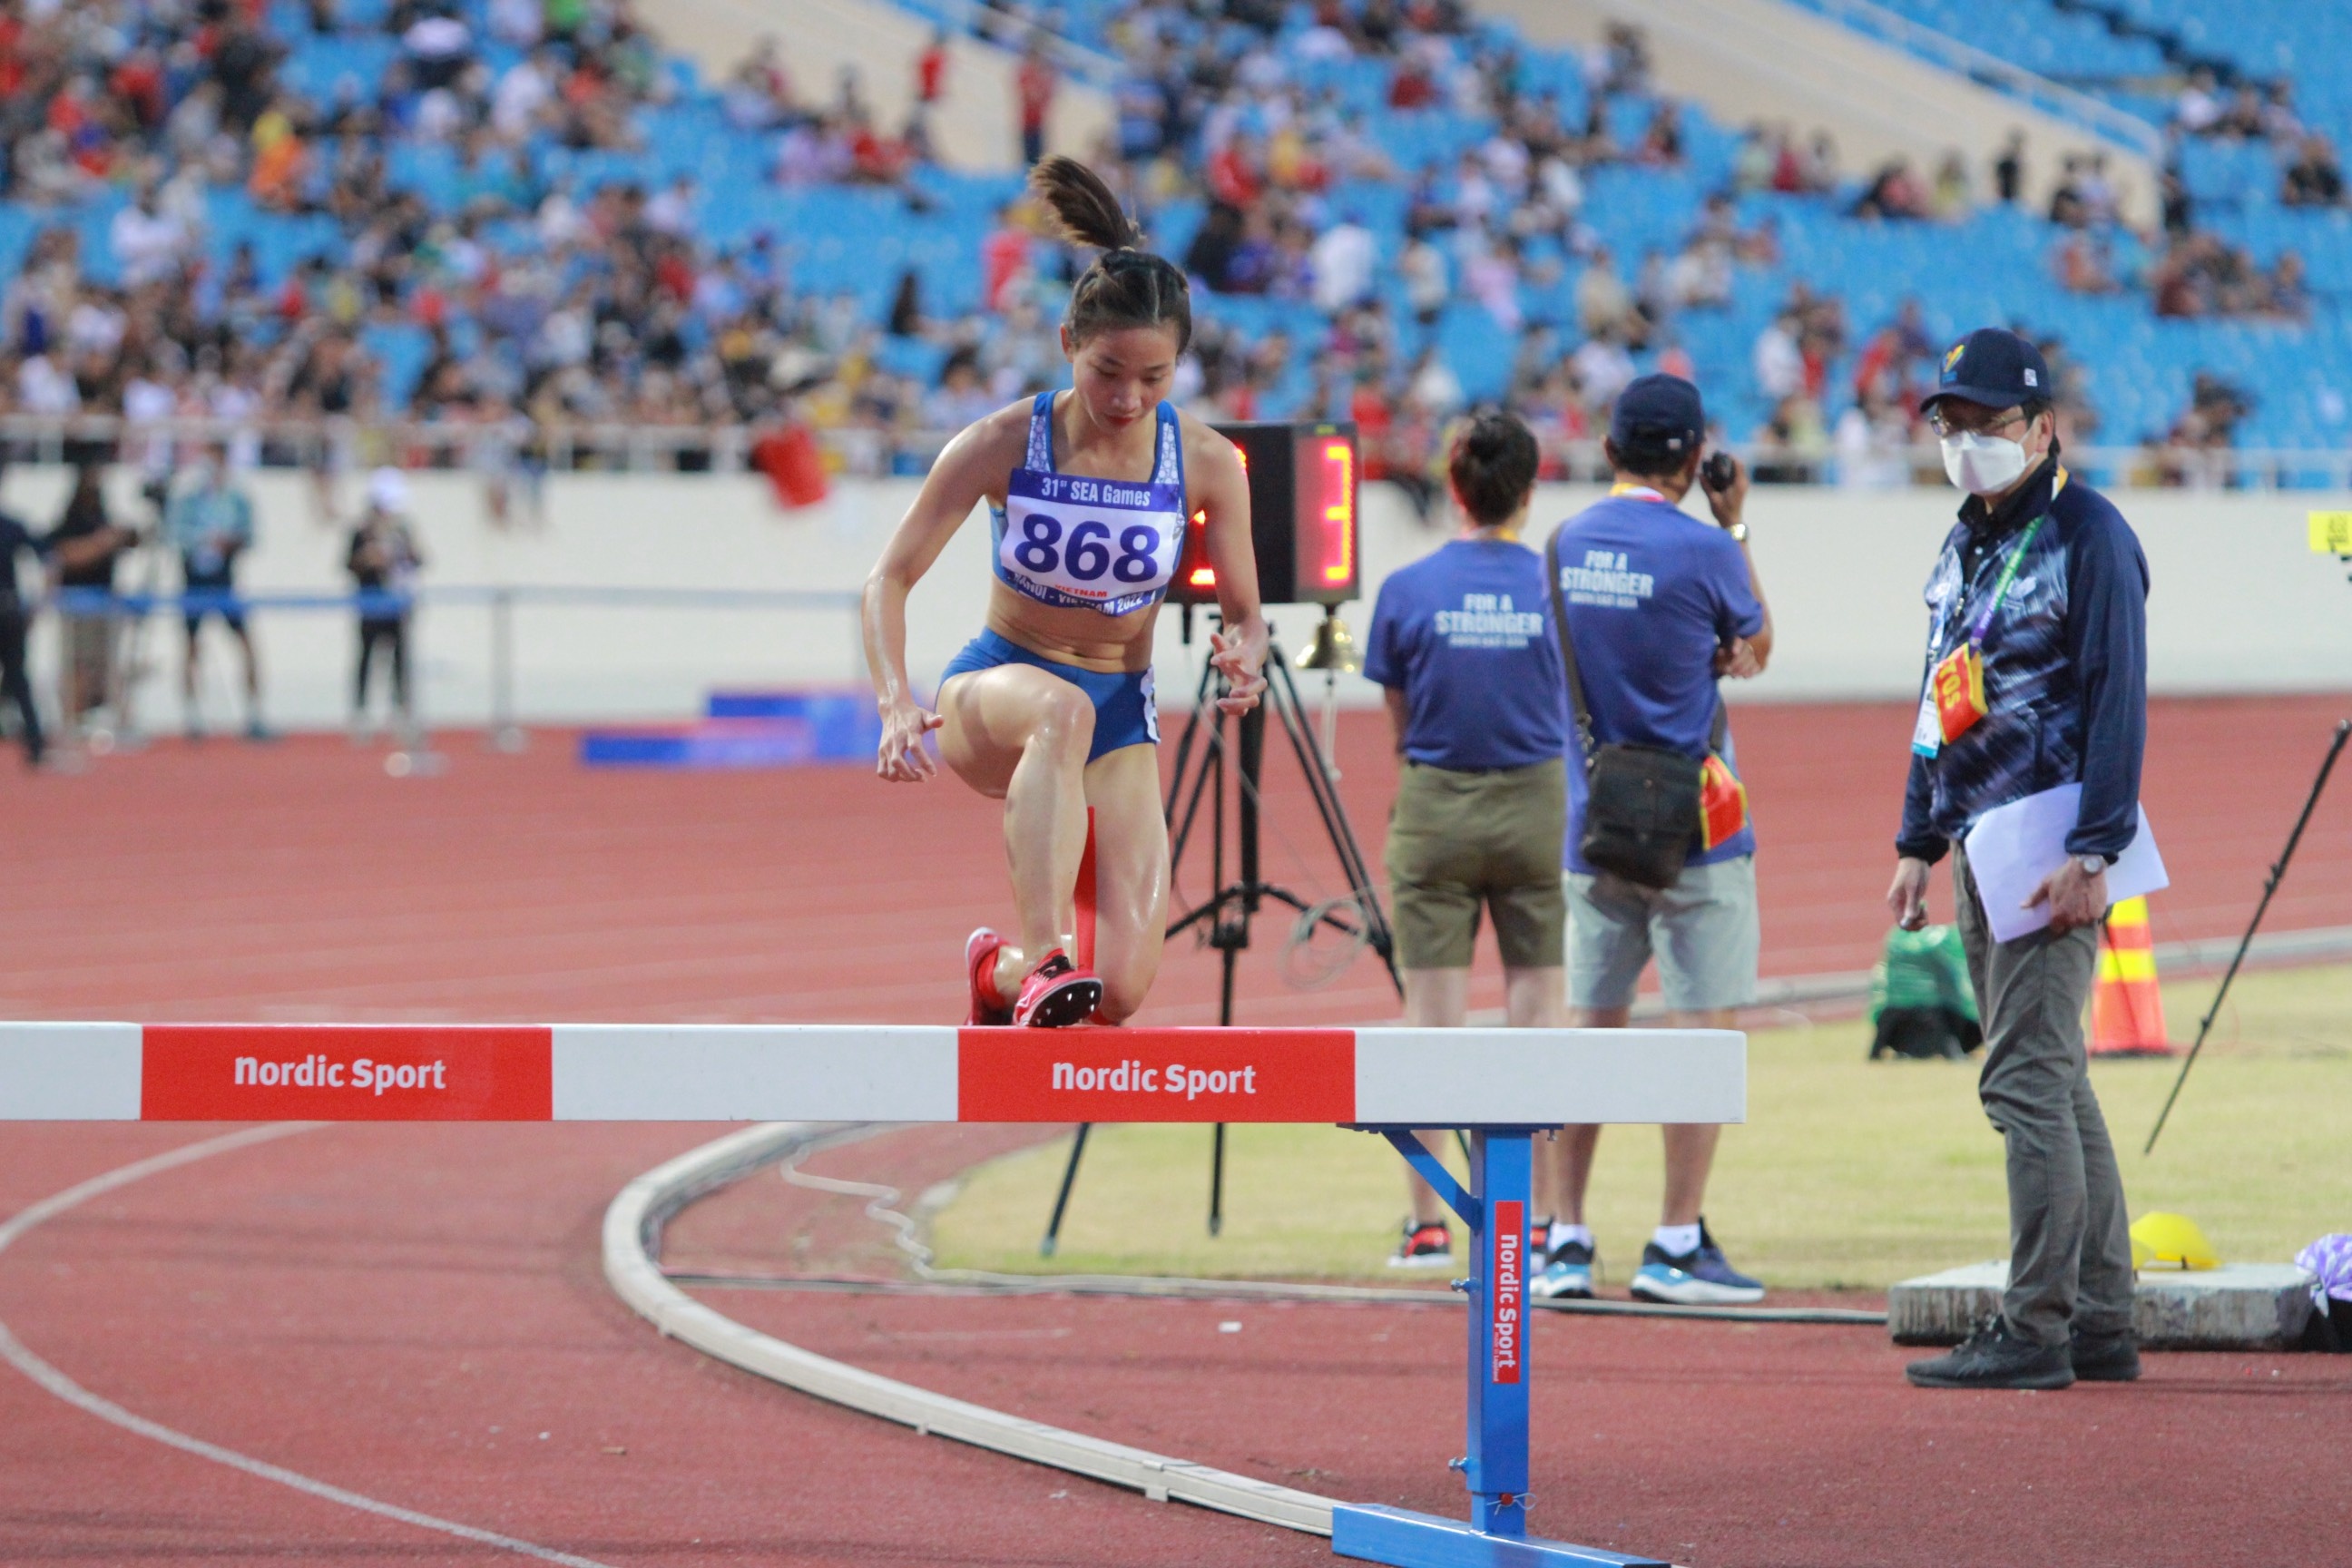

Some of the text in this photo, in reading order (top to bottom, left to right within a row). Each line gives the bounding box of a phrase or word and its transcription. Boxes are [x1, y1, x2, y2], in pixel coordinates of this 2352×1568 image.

[1071, 480, 1099, 503] SEA
[1102, 484, 1152, 507] Games
[1014, 514, 1160, 583] 868
[1559, 565, 1655, 599] STRONGER
[1433, 610, 1544, 637] STRONGER
[350, 1058, 447, 1097] Sport
[1164, 1063, 1257, 1102] Sport
[1494, 1307, 1518, 1369] Sport
